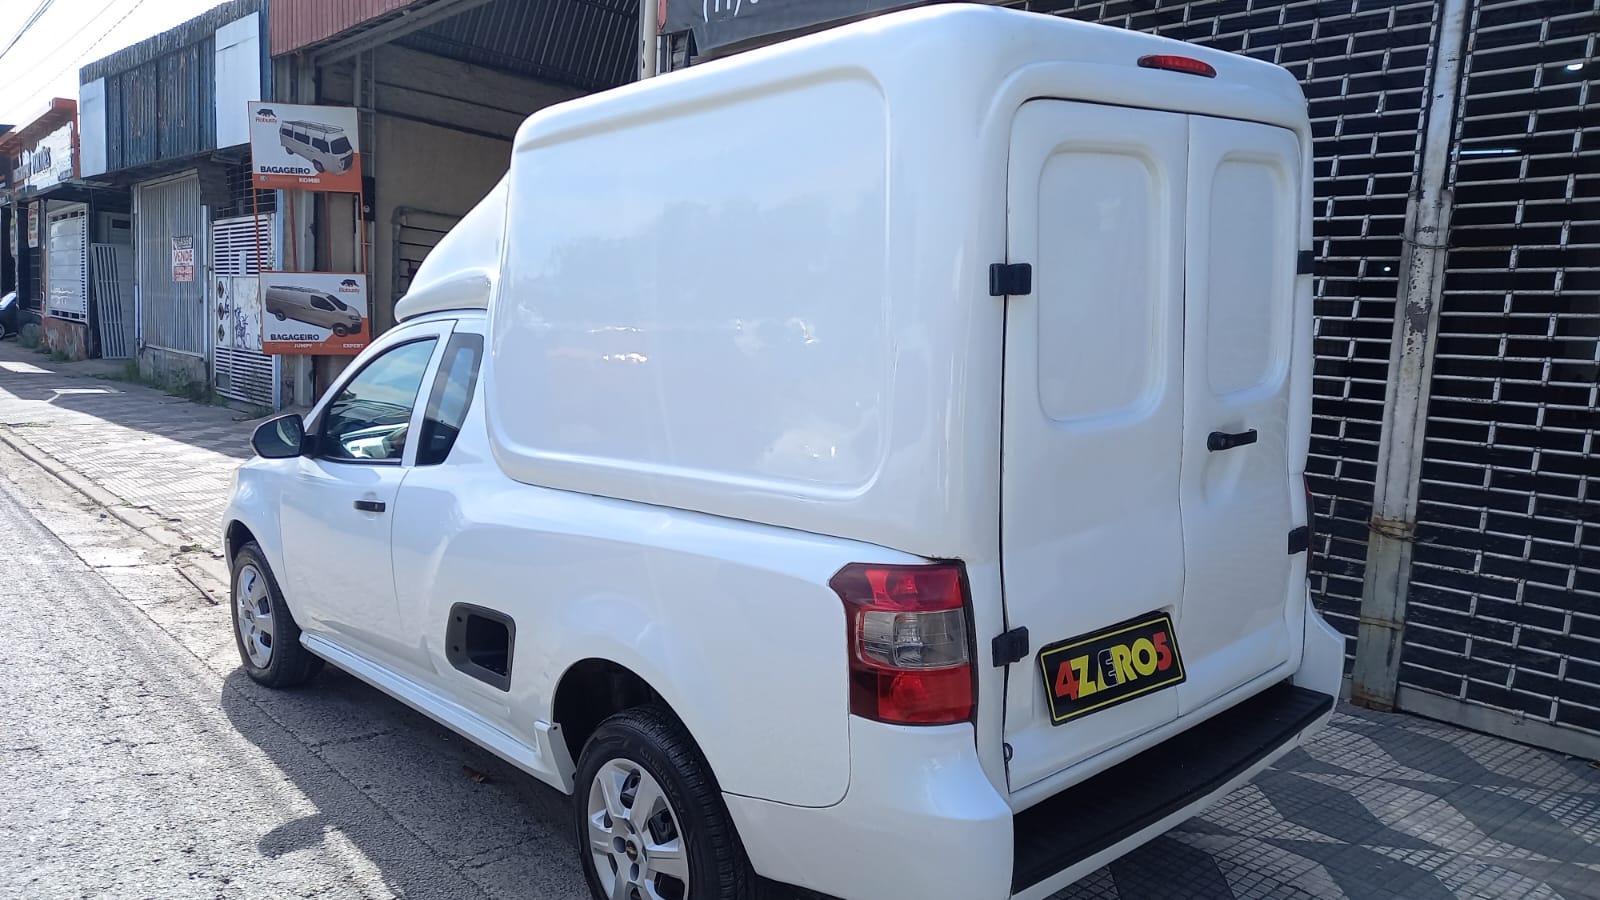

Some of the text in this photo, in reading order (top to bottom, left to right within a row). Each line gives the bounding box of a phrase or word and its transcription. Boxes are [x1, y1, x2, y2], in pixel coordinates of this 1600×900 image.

[260, 165, 311, 175] BAGAGEIRO
[270, 333, 320, 341] BAGAGEIRO
[1054, 631, 1173, 701] 4ZERO5
